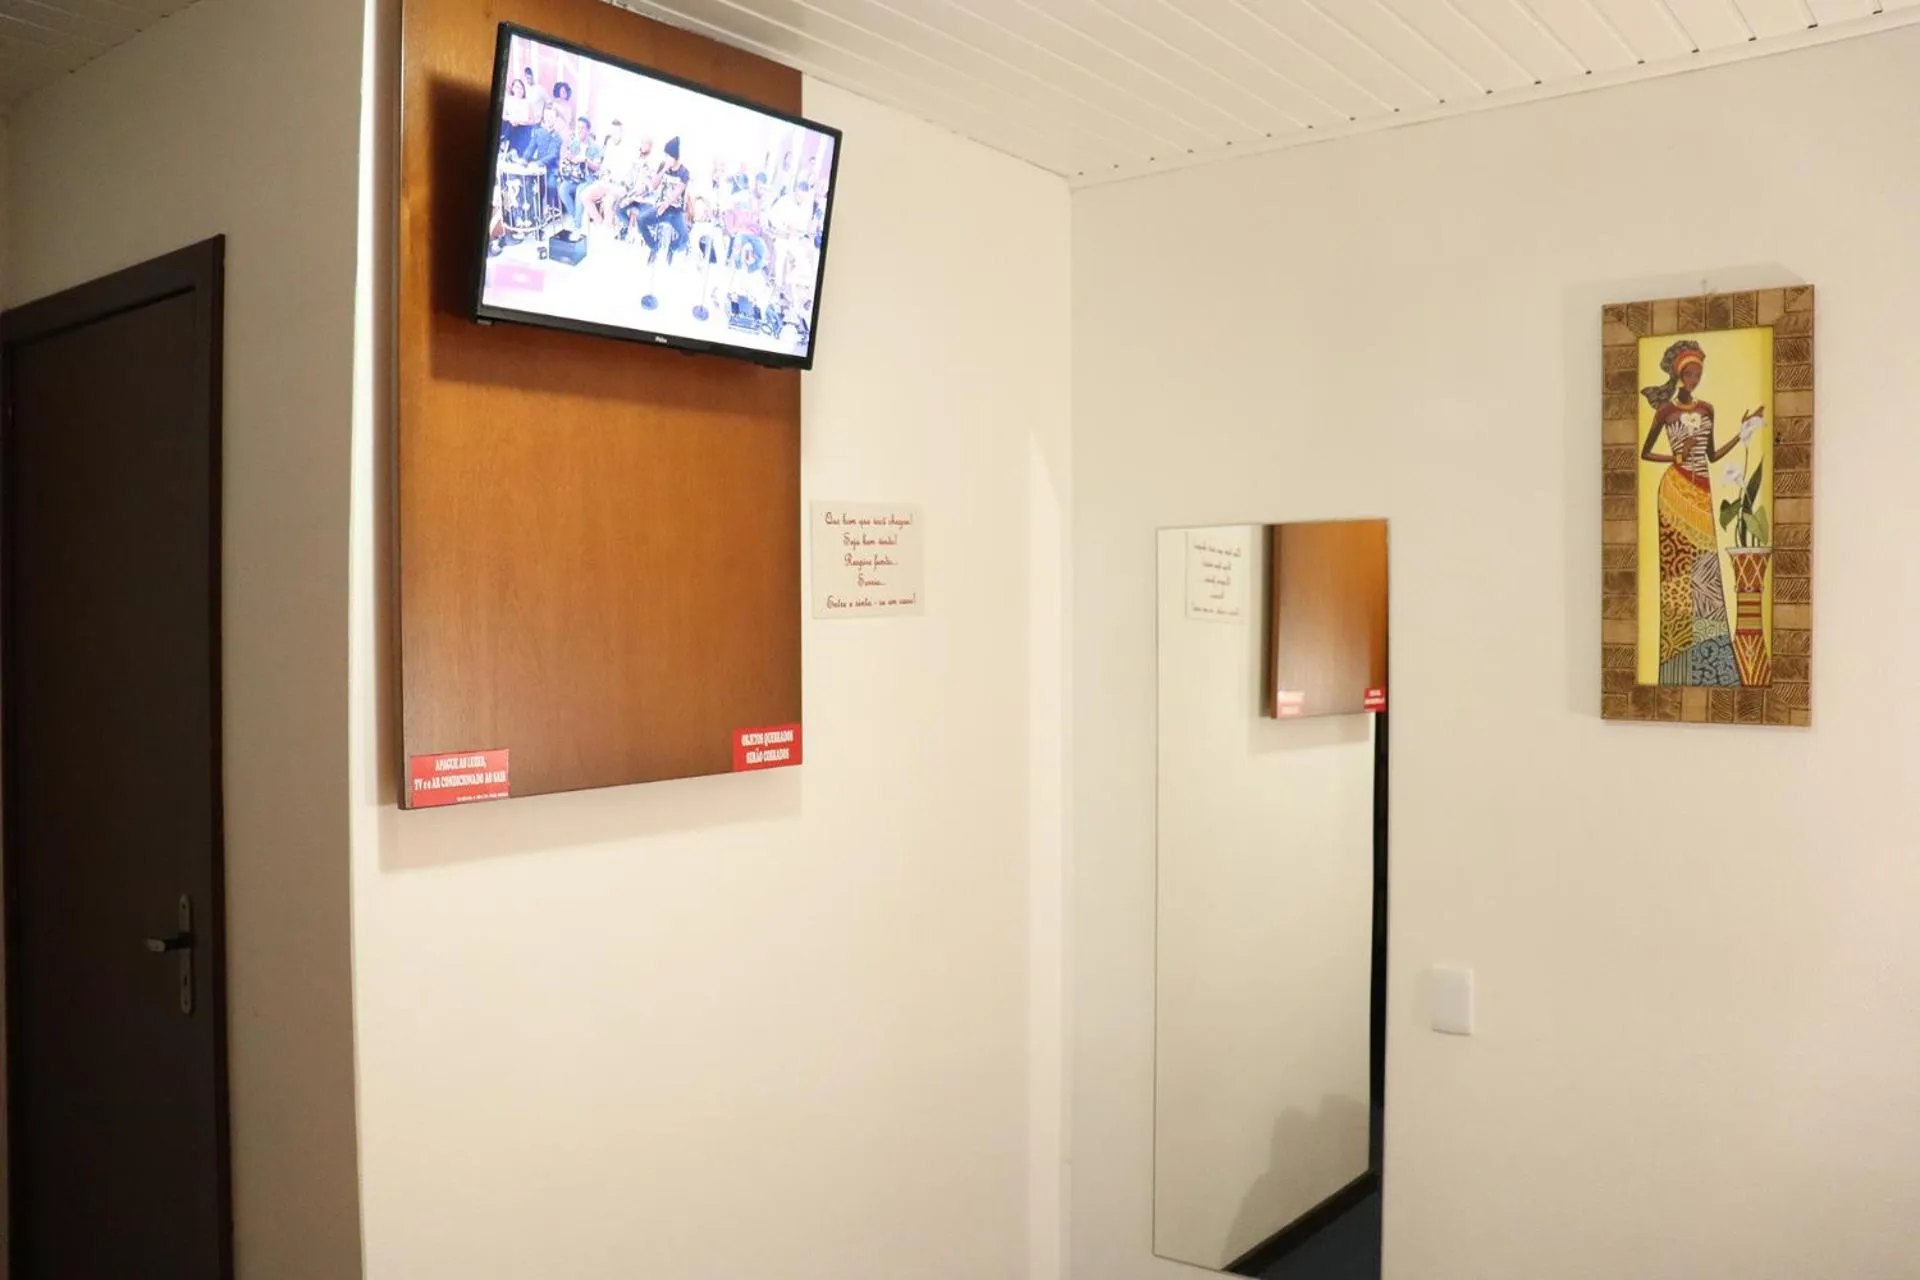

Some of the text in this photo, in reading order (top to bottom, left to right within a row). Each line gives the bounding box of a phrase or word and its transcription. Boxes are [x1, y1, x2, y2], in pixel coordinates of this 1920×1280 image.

[825, 511, 840, 525] Que
[843, 512, 857, 525] bom
[859, 519, 870, 529] que
[842, 532, 860, 550] Seja
[862, 534, 876, 545] bem
[826, 595, 846, 609] Entre
[741, 729, 794, 747] OBJETOS QUEBRADOS
[435, 757, 459, 771] APAGUE
[459, 757, 467, 769] AS
[746, 747, 790, 764] SERÃO COBRADOS
[414, 778, 423, 791] TV
[432, 777, 441, 789] AR
[441, 773, 484, 788] CONDICIONADO
[493, 770, 506, 783] SAIR
